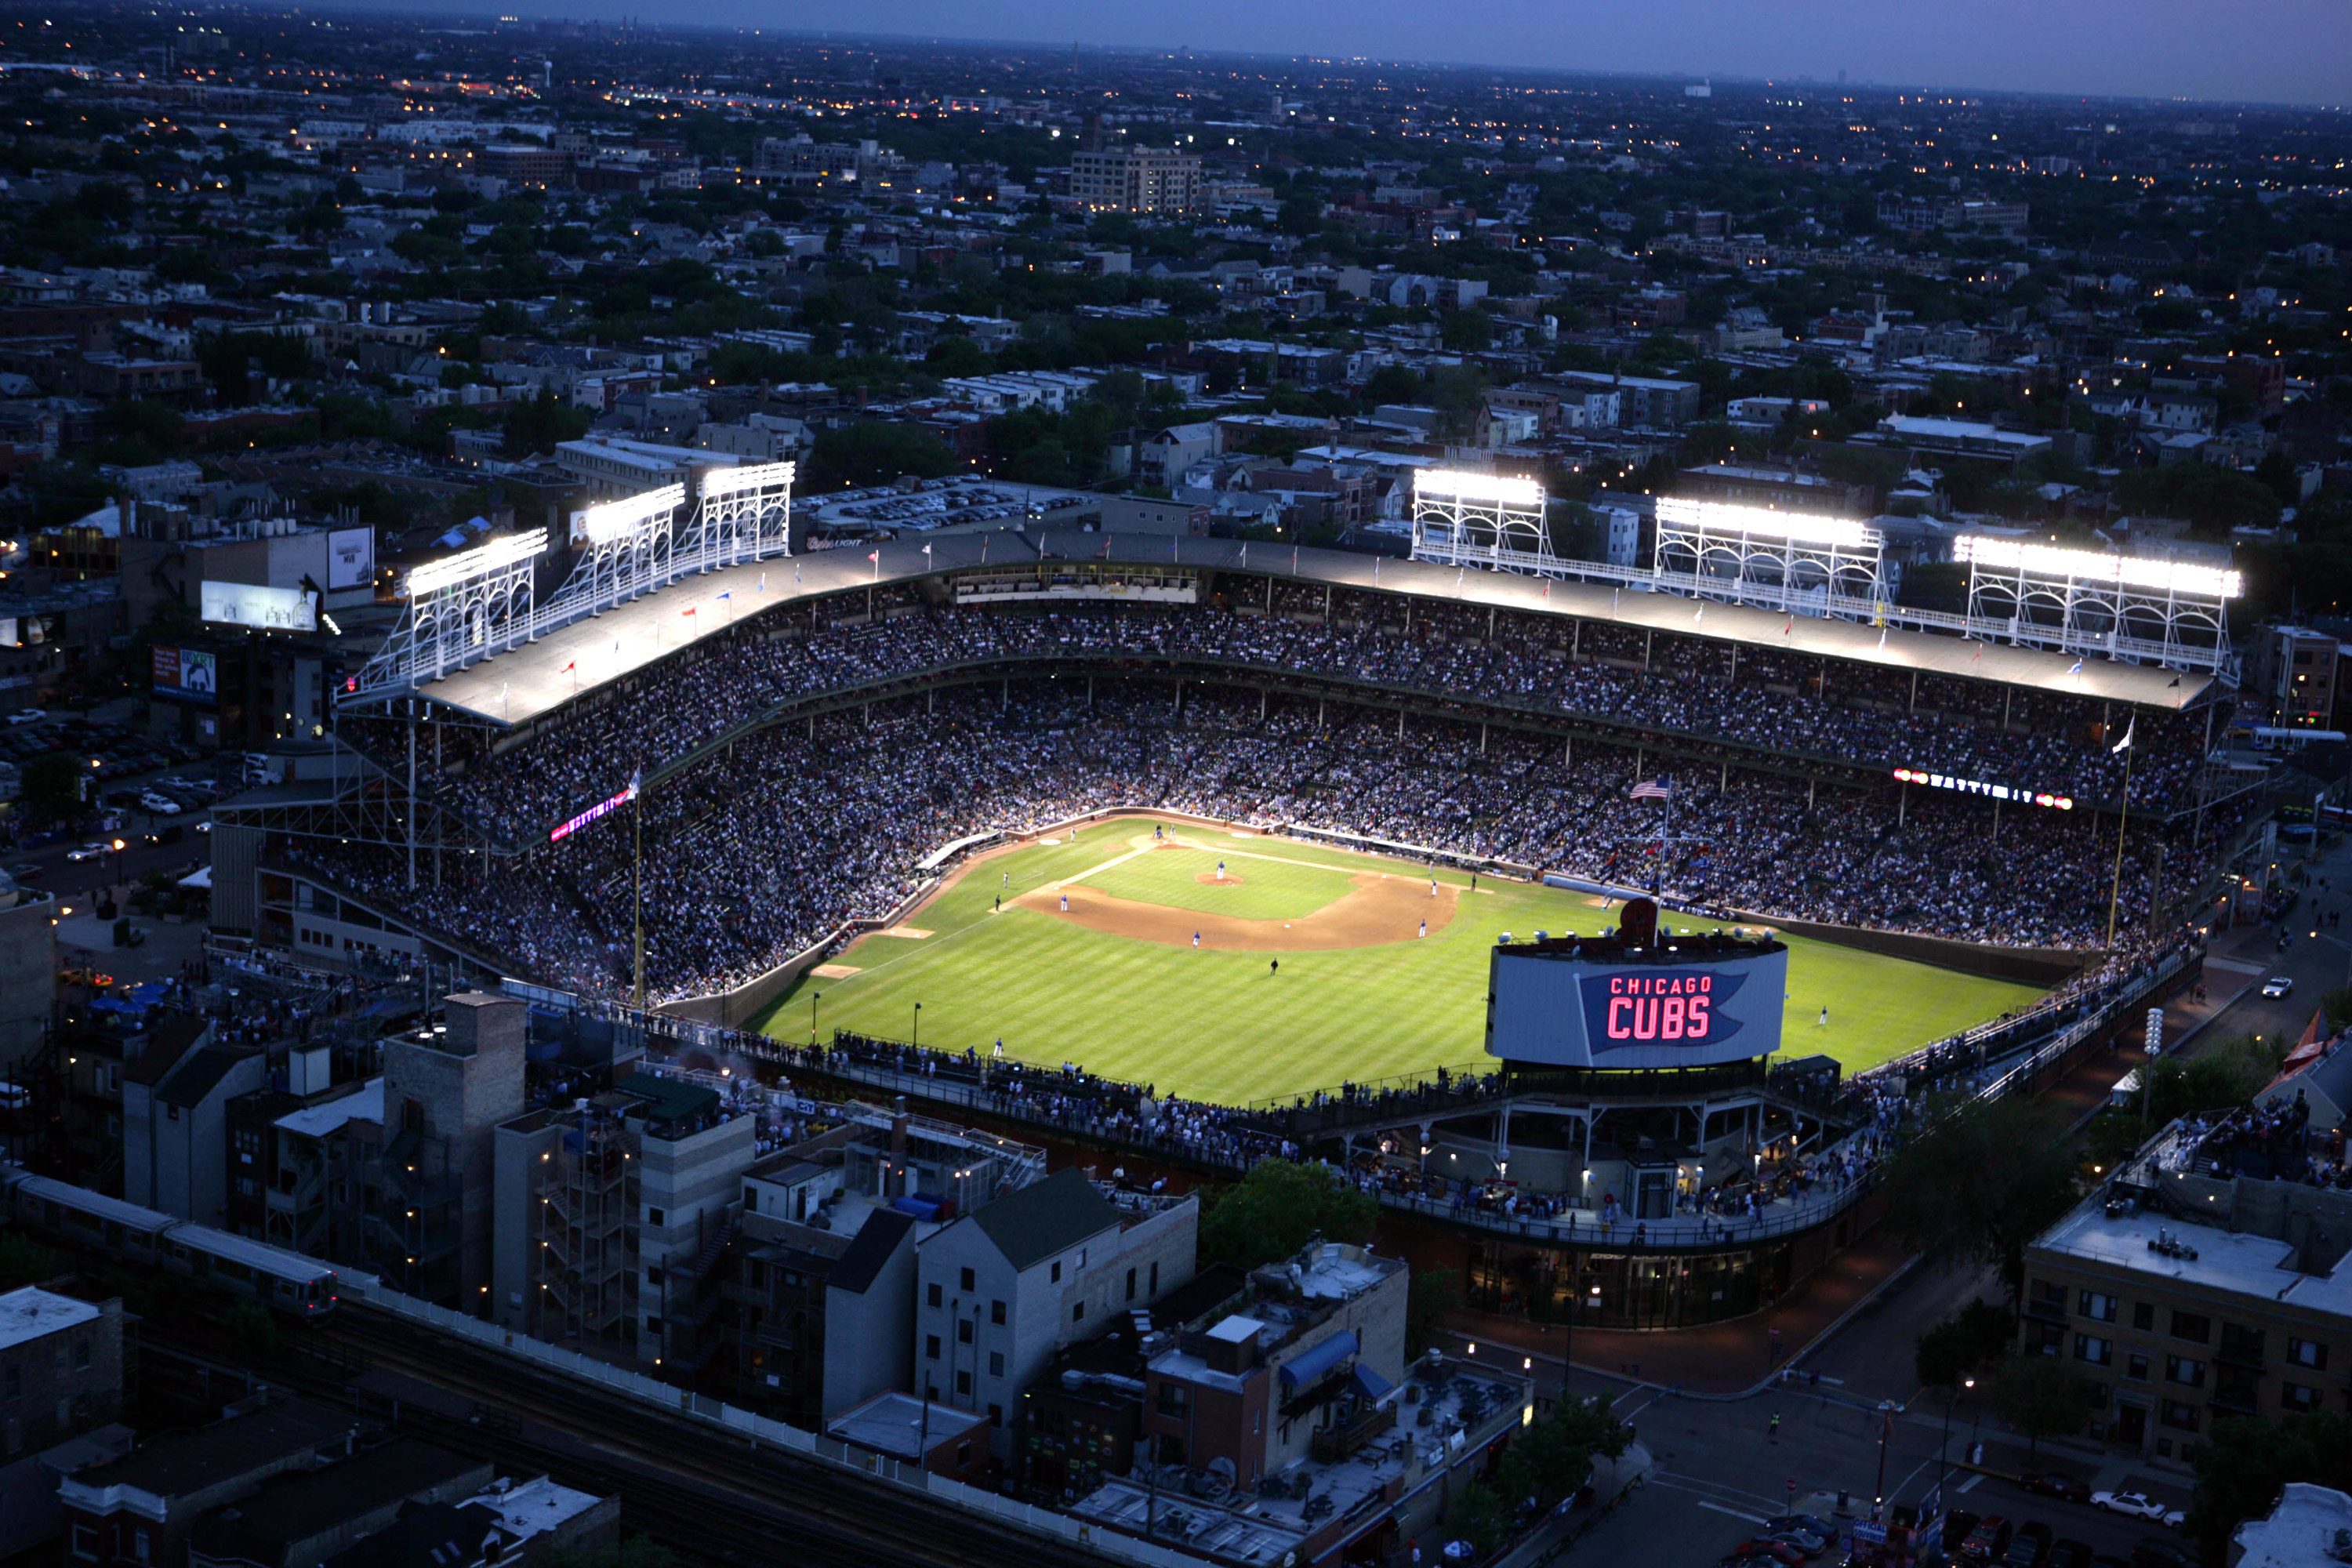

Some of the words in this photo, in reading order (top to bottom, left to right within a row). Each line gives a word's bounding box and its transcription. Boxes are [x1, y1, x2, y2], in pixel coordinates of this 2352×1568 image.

[834, 539, 863, 548] LIGHT
[1610, 975, 1711, 995] CHICAGO
[1607, 995, 1711, 1040] CUBS
[1853, 1519, 1886, 1533] OFFICIAL
